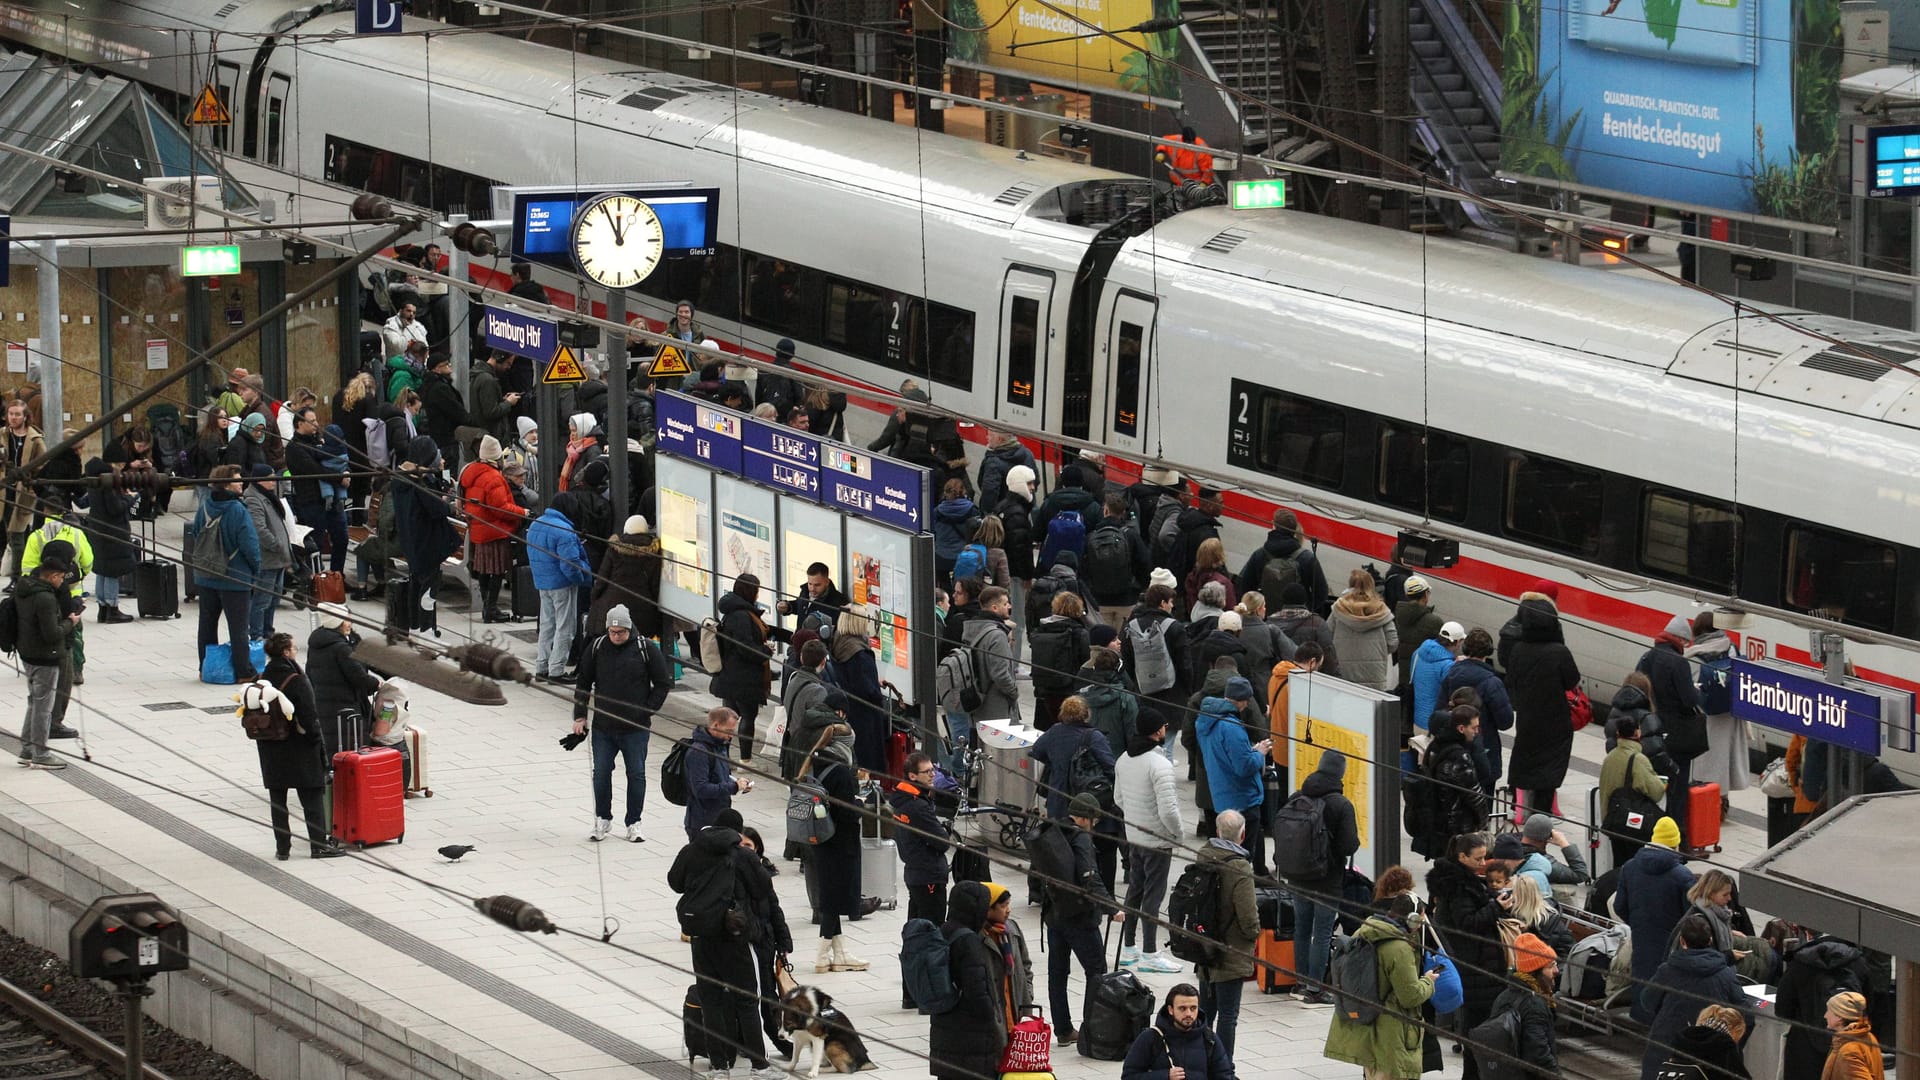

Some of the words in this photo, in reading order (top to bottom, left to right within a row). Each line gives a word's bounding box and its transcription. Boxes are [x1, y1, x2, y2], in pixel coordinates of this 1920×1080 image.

[1603, 90, 1658, 111] QUADRATISCH.
[1659, 99, 1701, 118] PRAKTISCH.
[1701, 106, 1720, 120] GUT.
[1603, 112, 1721, 159] #entdeckedasgut
[328, 143, 335, 168] 2
[689, 248, 706, 256] Gleis
[708, 247, 716, 255] 12
[891, 301, 900, 330] 2
[489, 313, 525, 349] Hamburg
[526, 324, 541, 349] Hbf
[1238, 392, 1249, 424] 2
[1739, 672, 1813, 726] Hamburg
[1818, 693, 1848, 729] Hbf
[1011, 1040, 1047, 1053] ARHOJ
[1014, 1030, 1048, 1042] STUDIO
